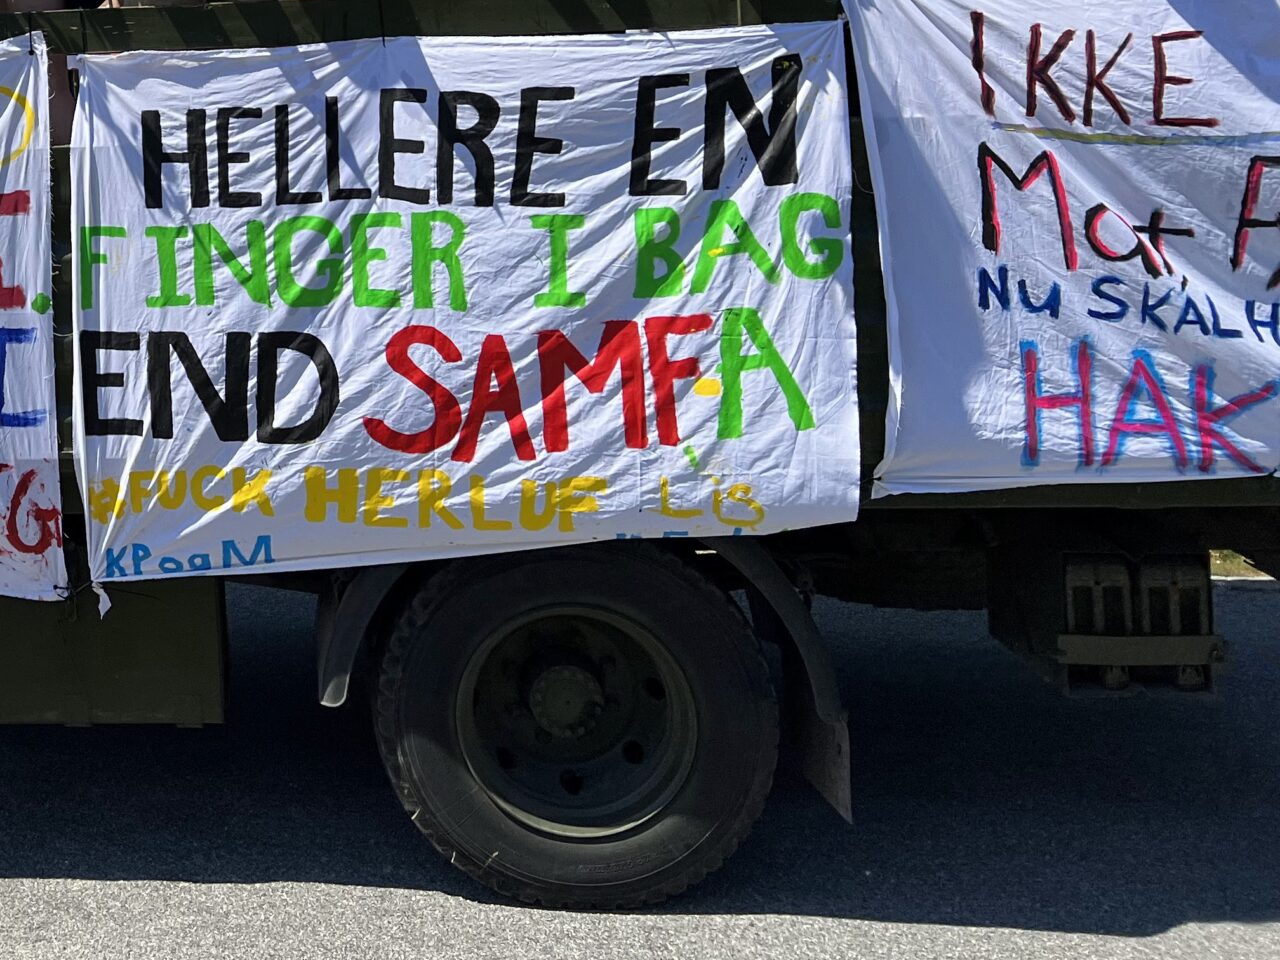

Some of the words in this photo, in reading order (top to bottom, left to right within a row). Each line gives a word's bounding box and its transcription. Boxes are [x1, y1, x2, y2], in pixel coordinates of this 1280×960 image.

[969, 10, 1219, 127] IKKE
[140, 86, 575, 209] HELLERE
[628, 53, 803, 197] EN
[80, 209, 468, 312] FINGER
[529, 214, 587, 309] I
[632, 192, 843, 299] BAG
[977, 265, 1060, 320] NU
[80, 329, 340, 444] END
[90, 464, 275, 525] #FUCK
[304, 465, 607, 531] HERLUF
